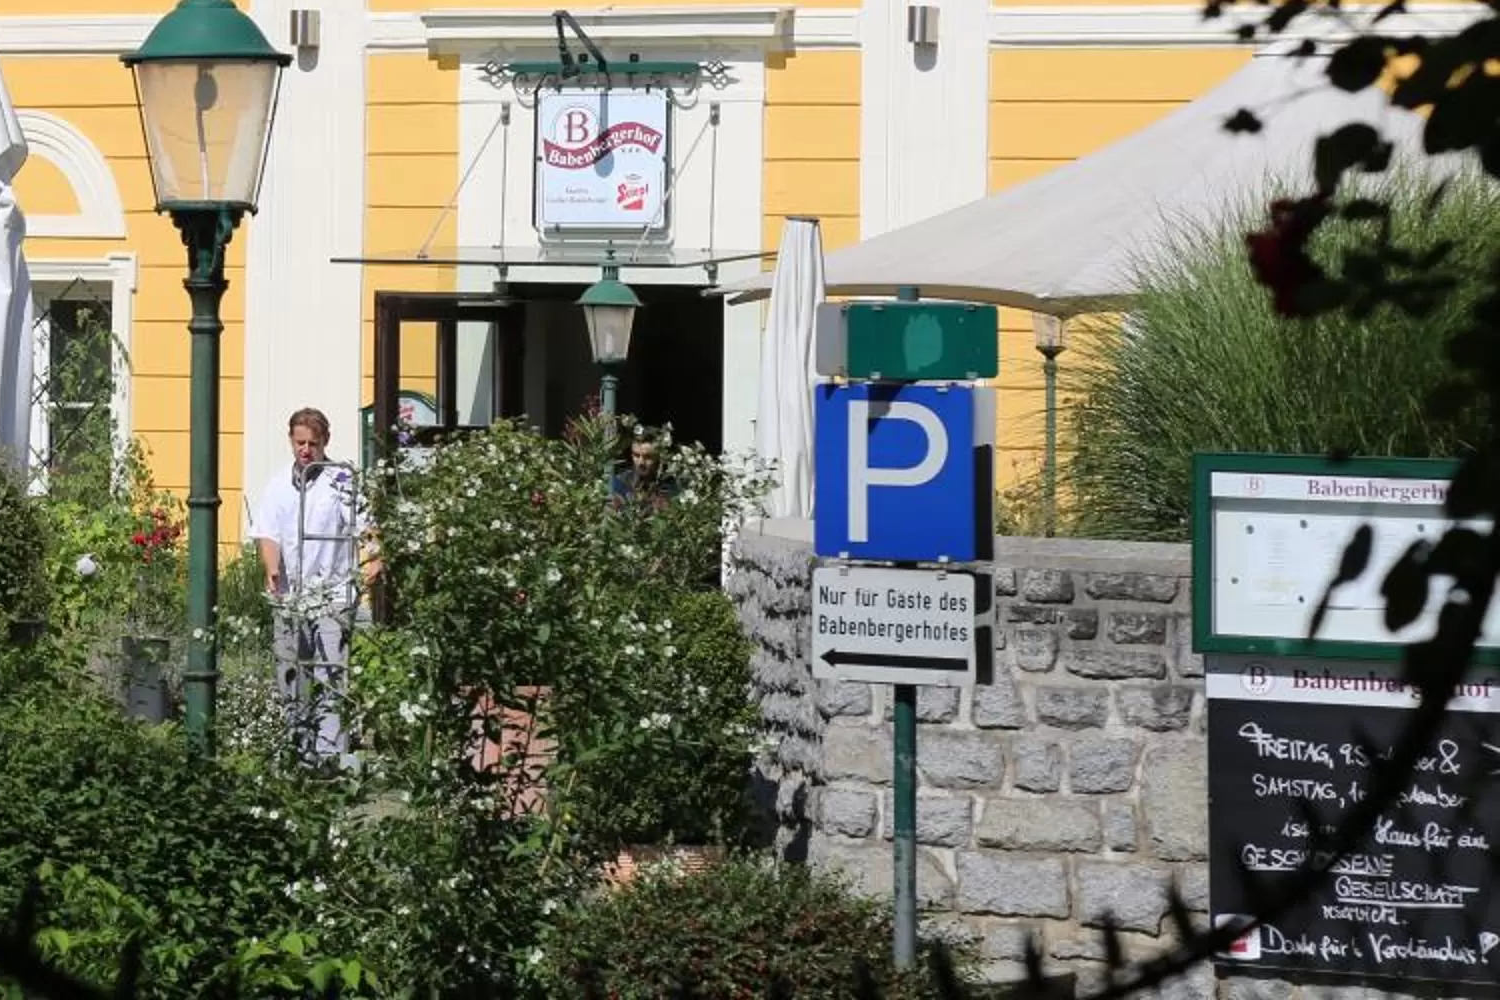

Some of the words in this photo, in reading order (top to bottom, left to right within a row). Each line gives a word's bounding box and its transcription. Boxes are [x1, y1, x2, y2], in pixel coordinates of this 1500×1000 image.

[564, 111, 589, 143] B
[548, 126, 660, 166] Babenbergerhof
[848, 399, 949, 543] P
[1307, 479, 1448, 501] Babenbergerh
[818, 585, 847, 606] Nur
[939, 591, 968, 612] des
[818, 614, 969, 643] Babenbergerhofes
[1249, 665, 1267, 686] B
[1251, 773, 1346, 809] SAMSTAG,
